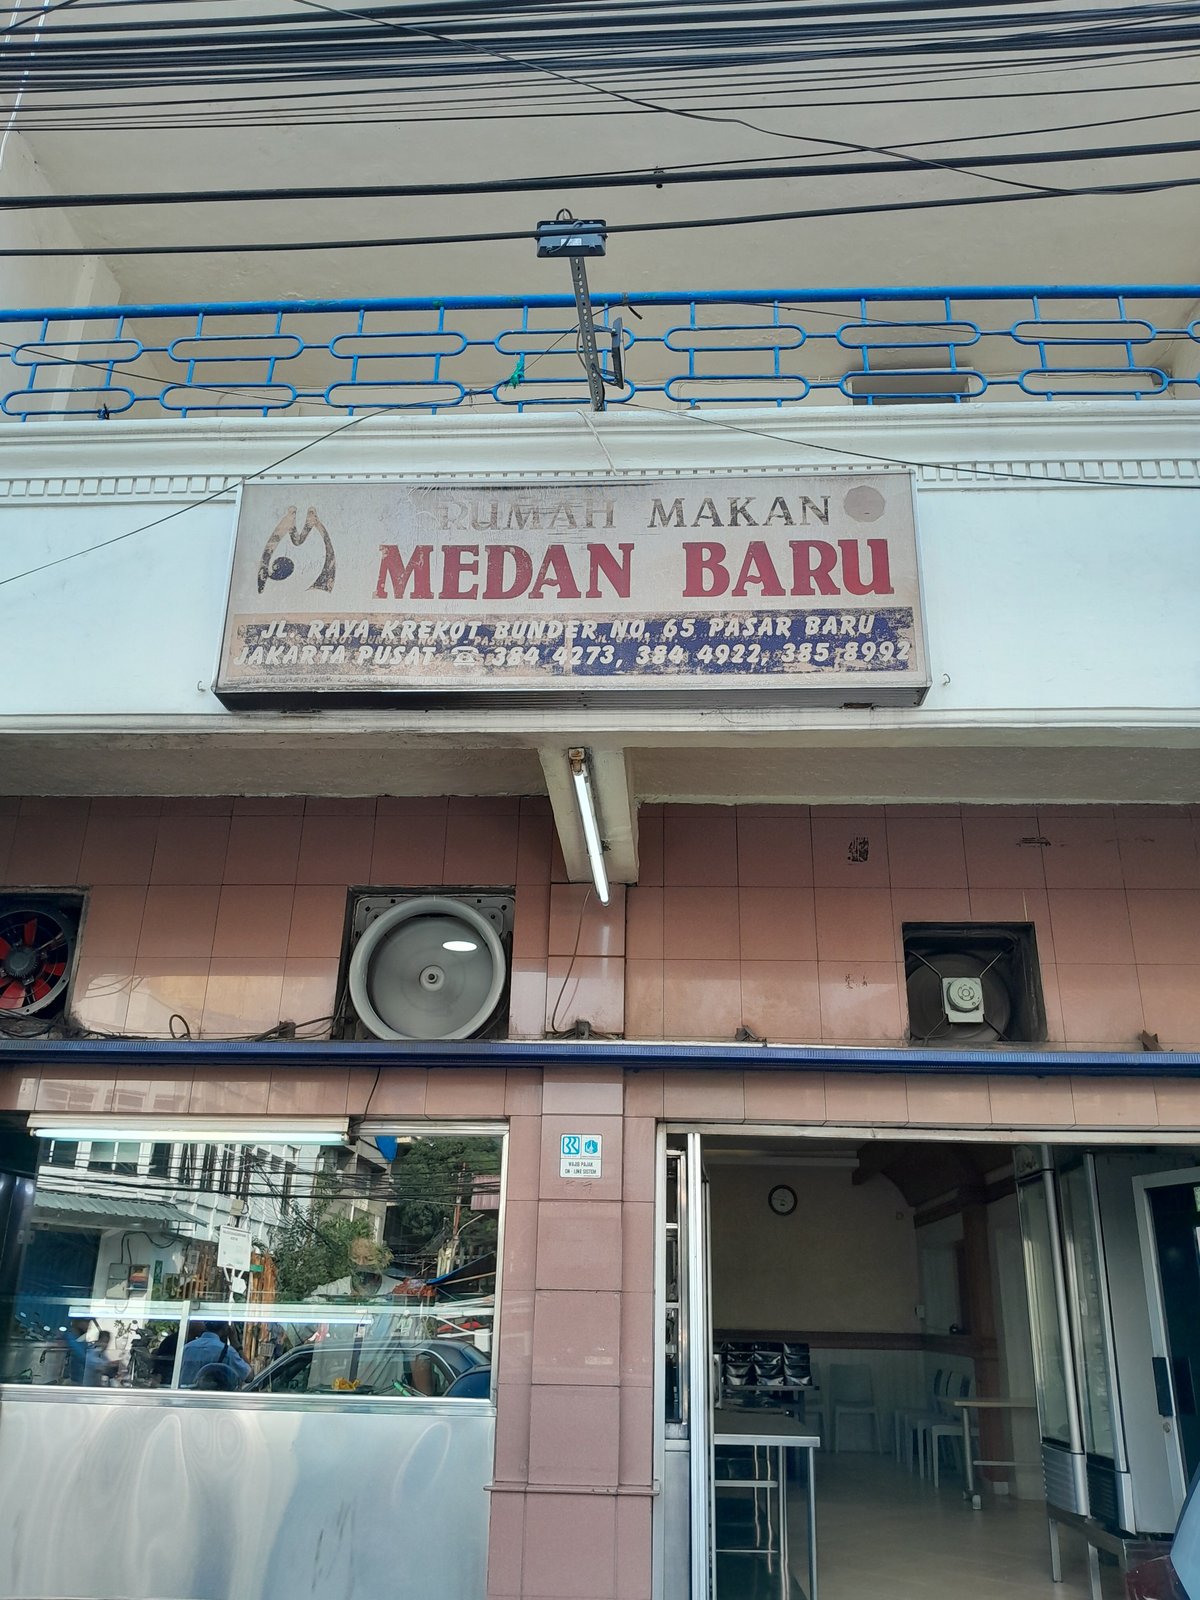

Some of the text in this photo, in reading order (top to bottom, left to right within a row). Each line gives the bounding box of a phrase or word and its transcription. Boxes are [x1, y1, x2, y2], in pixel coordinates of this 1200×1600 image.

[434, 495, 831, 531] RUMAH MAKAN
[372, 538, 895, 600] MEDAN BARU
[261, 620, 295, 639] JL.
[307, 619, 370, 639] RAYA
[380, 620, 482, 640] KREKOT
[494, 619, 598, 641] BUNDER
[609, 618, 651, 639] NO.
[662, 618, 697, 638] 65
[708, 616, 792, 640] PASAR
[804, 614, 876, 636] BARU
[233, 645, 347, 666] JAKARTA
[356, 645, 437, 667] PUSAT
[491, 646, 540, 667] 384
[551, 645, 624, 669] 4273,
[635, 644, 685, 665] 384
[780, 642, 831, 663] 385
[842, 640, 912, 662] 8992
